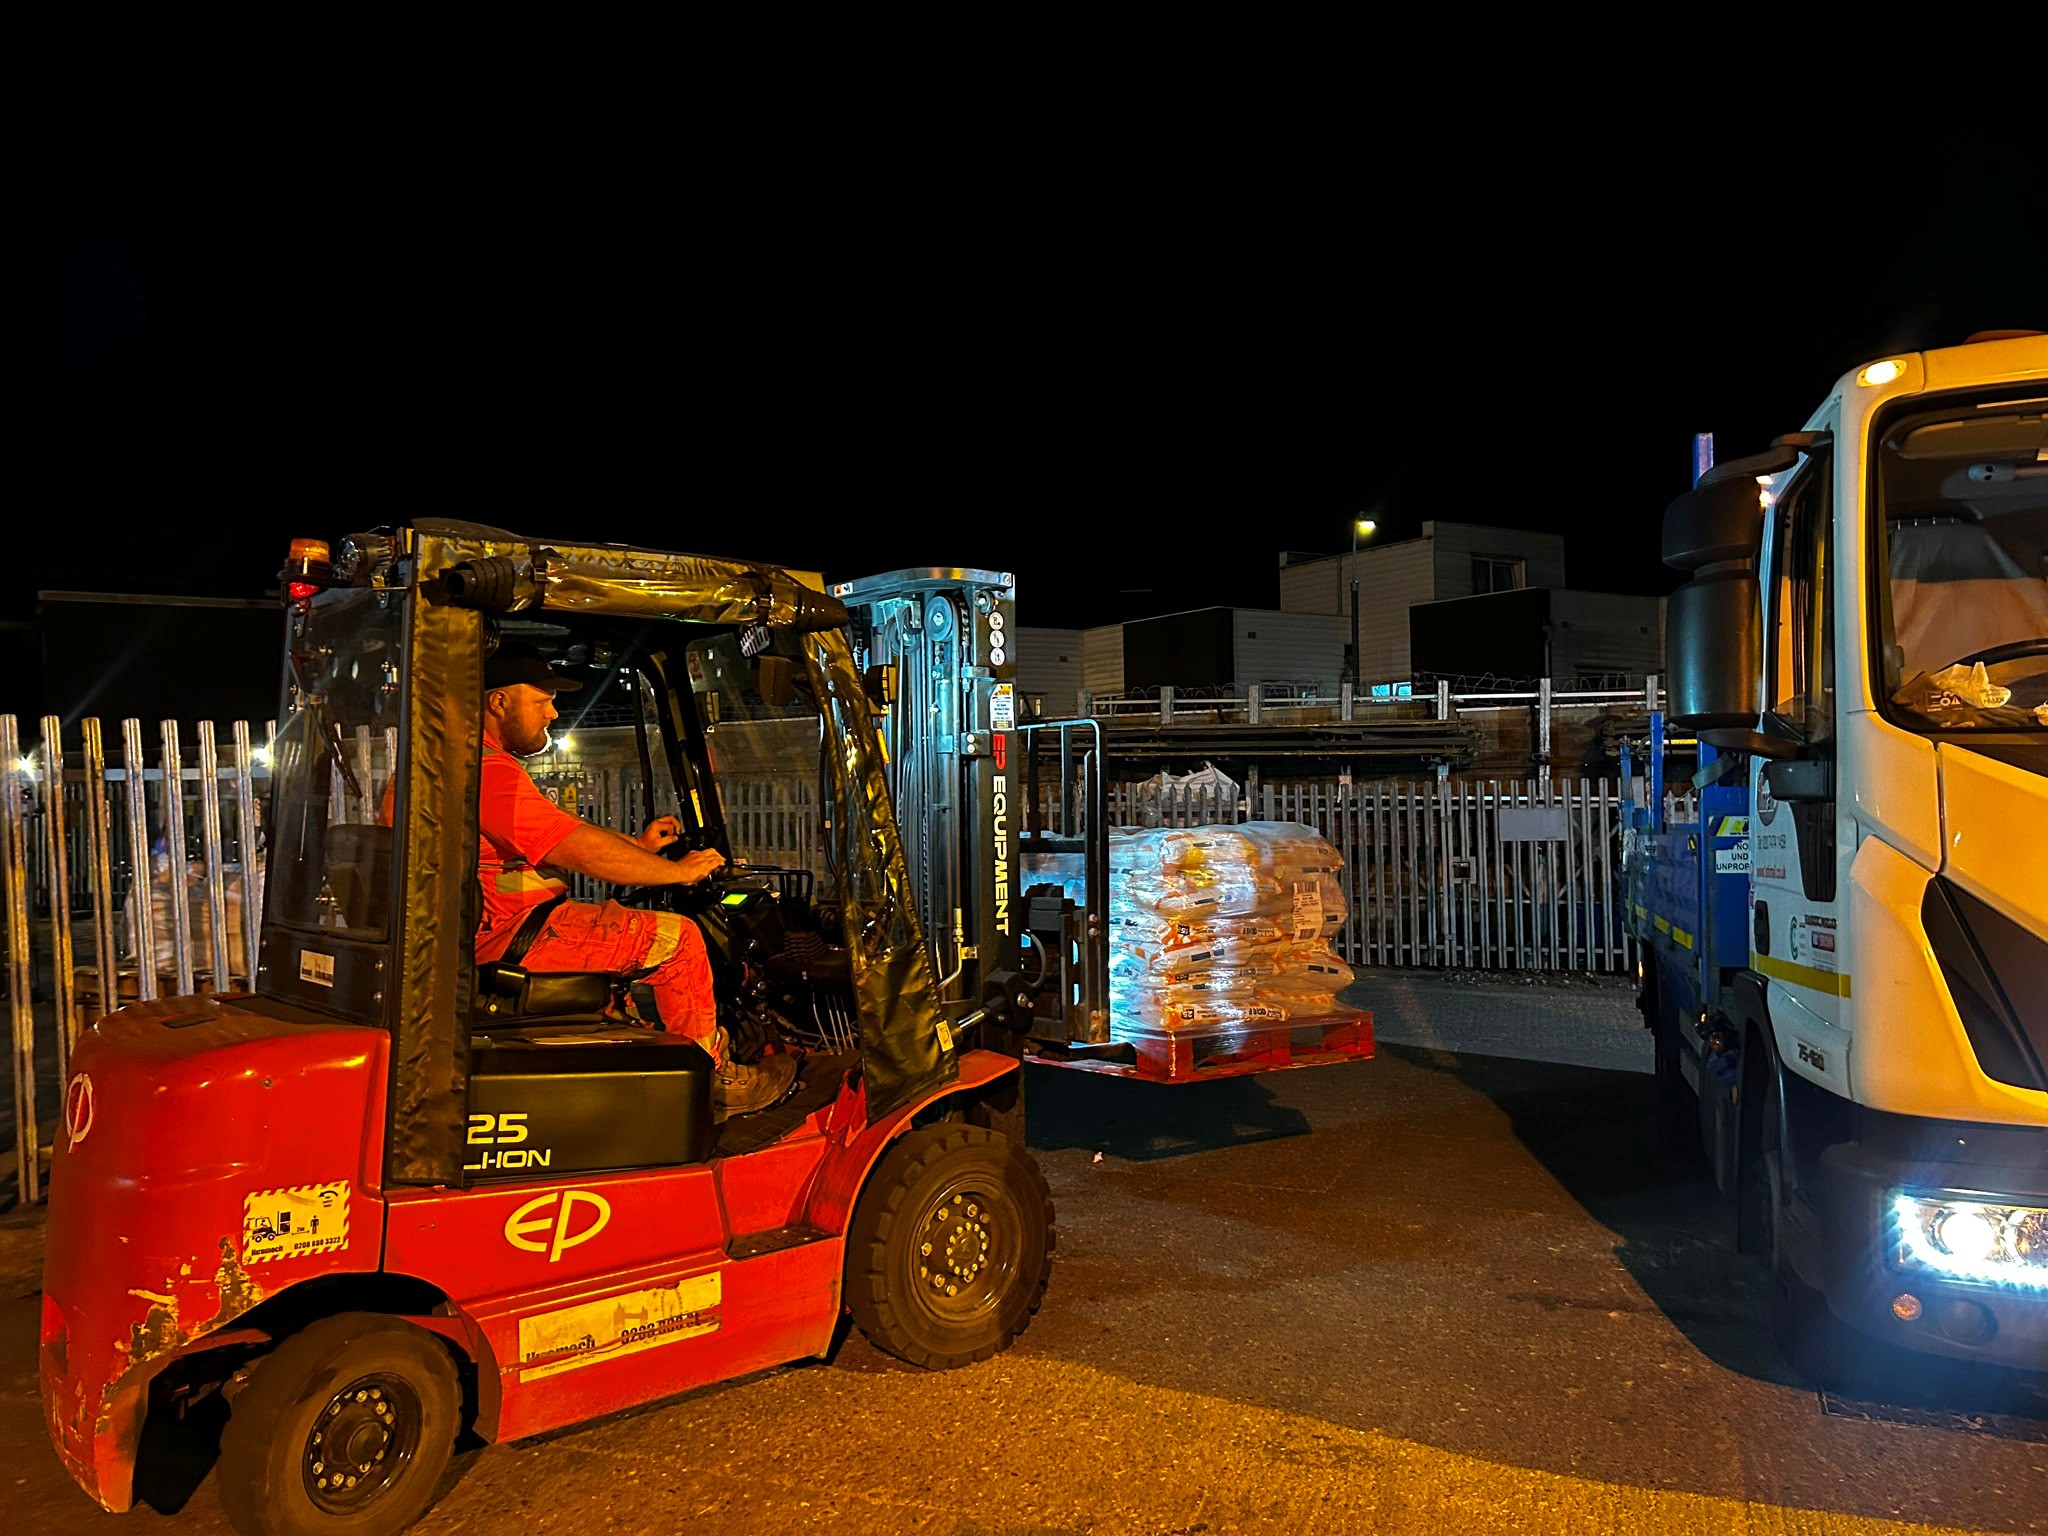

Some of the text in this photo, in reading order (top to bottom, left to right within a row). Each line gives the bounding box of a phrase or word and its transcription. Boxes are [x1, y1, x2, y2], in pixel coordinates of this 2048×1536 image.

[993, 734, 1006, 770] EP
[993, 775, 1009, 936] EQUIPMENT
[1731, 853, 1749, 861] UND
[467, 1113, 528, 1144] 25
[504, 1190, 611, 1263] EP
[294, 1240, 311, 1250] 0208
